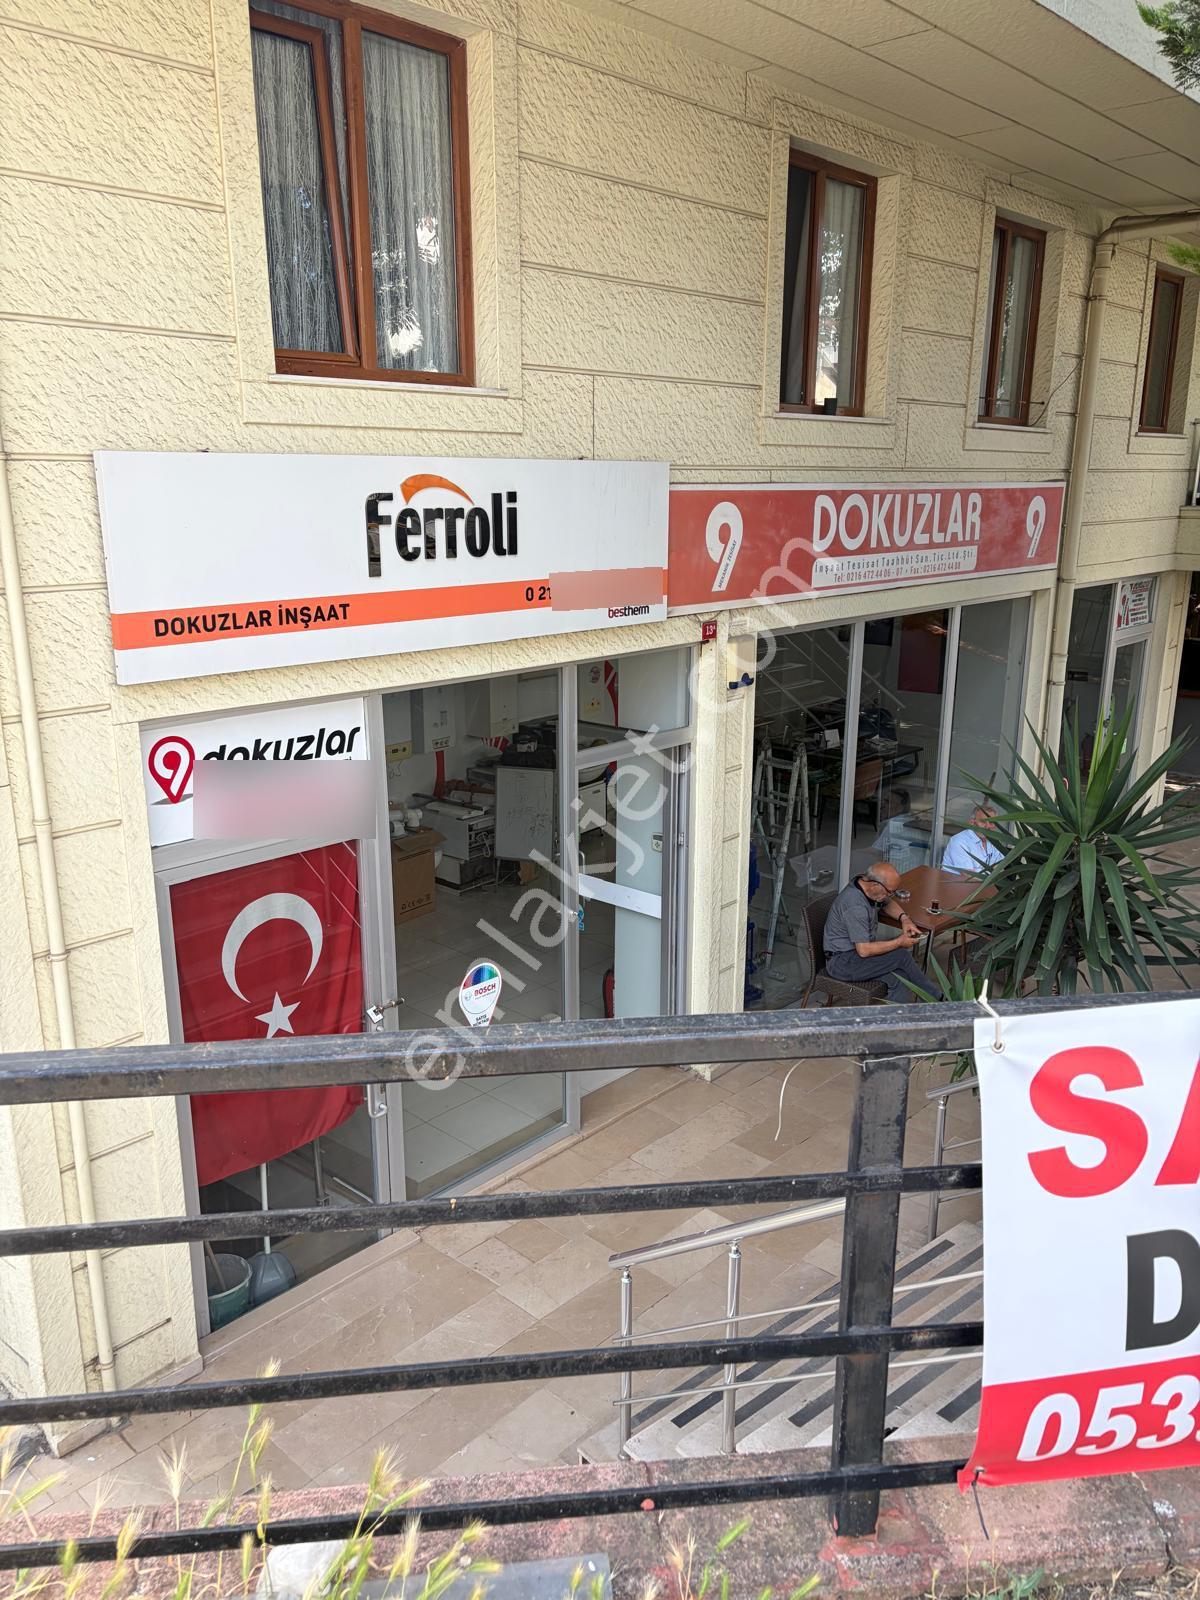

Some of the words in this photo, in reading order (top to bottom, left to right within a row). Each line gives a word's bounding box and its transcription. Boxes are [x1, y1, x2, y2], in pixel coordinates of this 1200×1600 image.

[365, 491, 518, 577] Ferroli
[812, 491, 982, 552] DOKUZLAR
[706, 501, 743, 592] 9
[846, 557, 878, 570] Tesisat
[154, 610, 272, 637] DOKUZLAR
[278, 603, 350, 628] İNŞAAT
[607, 605, 650, 619] bestherm
[474, 982, 496, 996] BOSCH
[1016, 1373, 1200, 1462] 053
